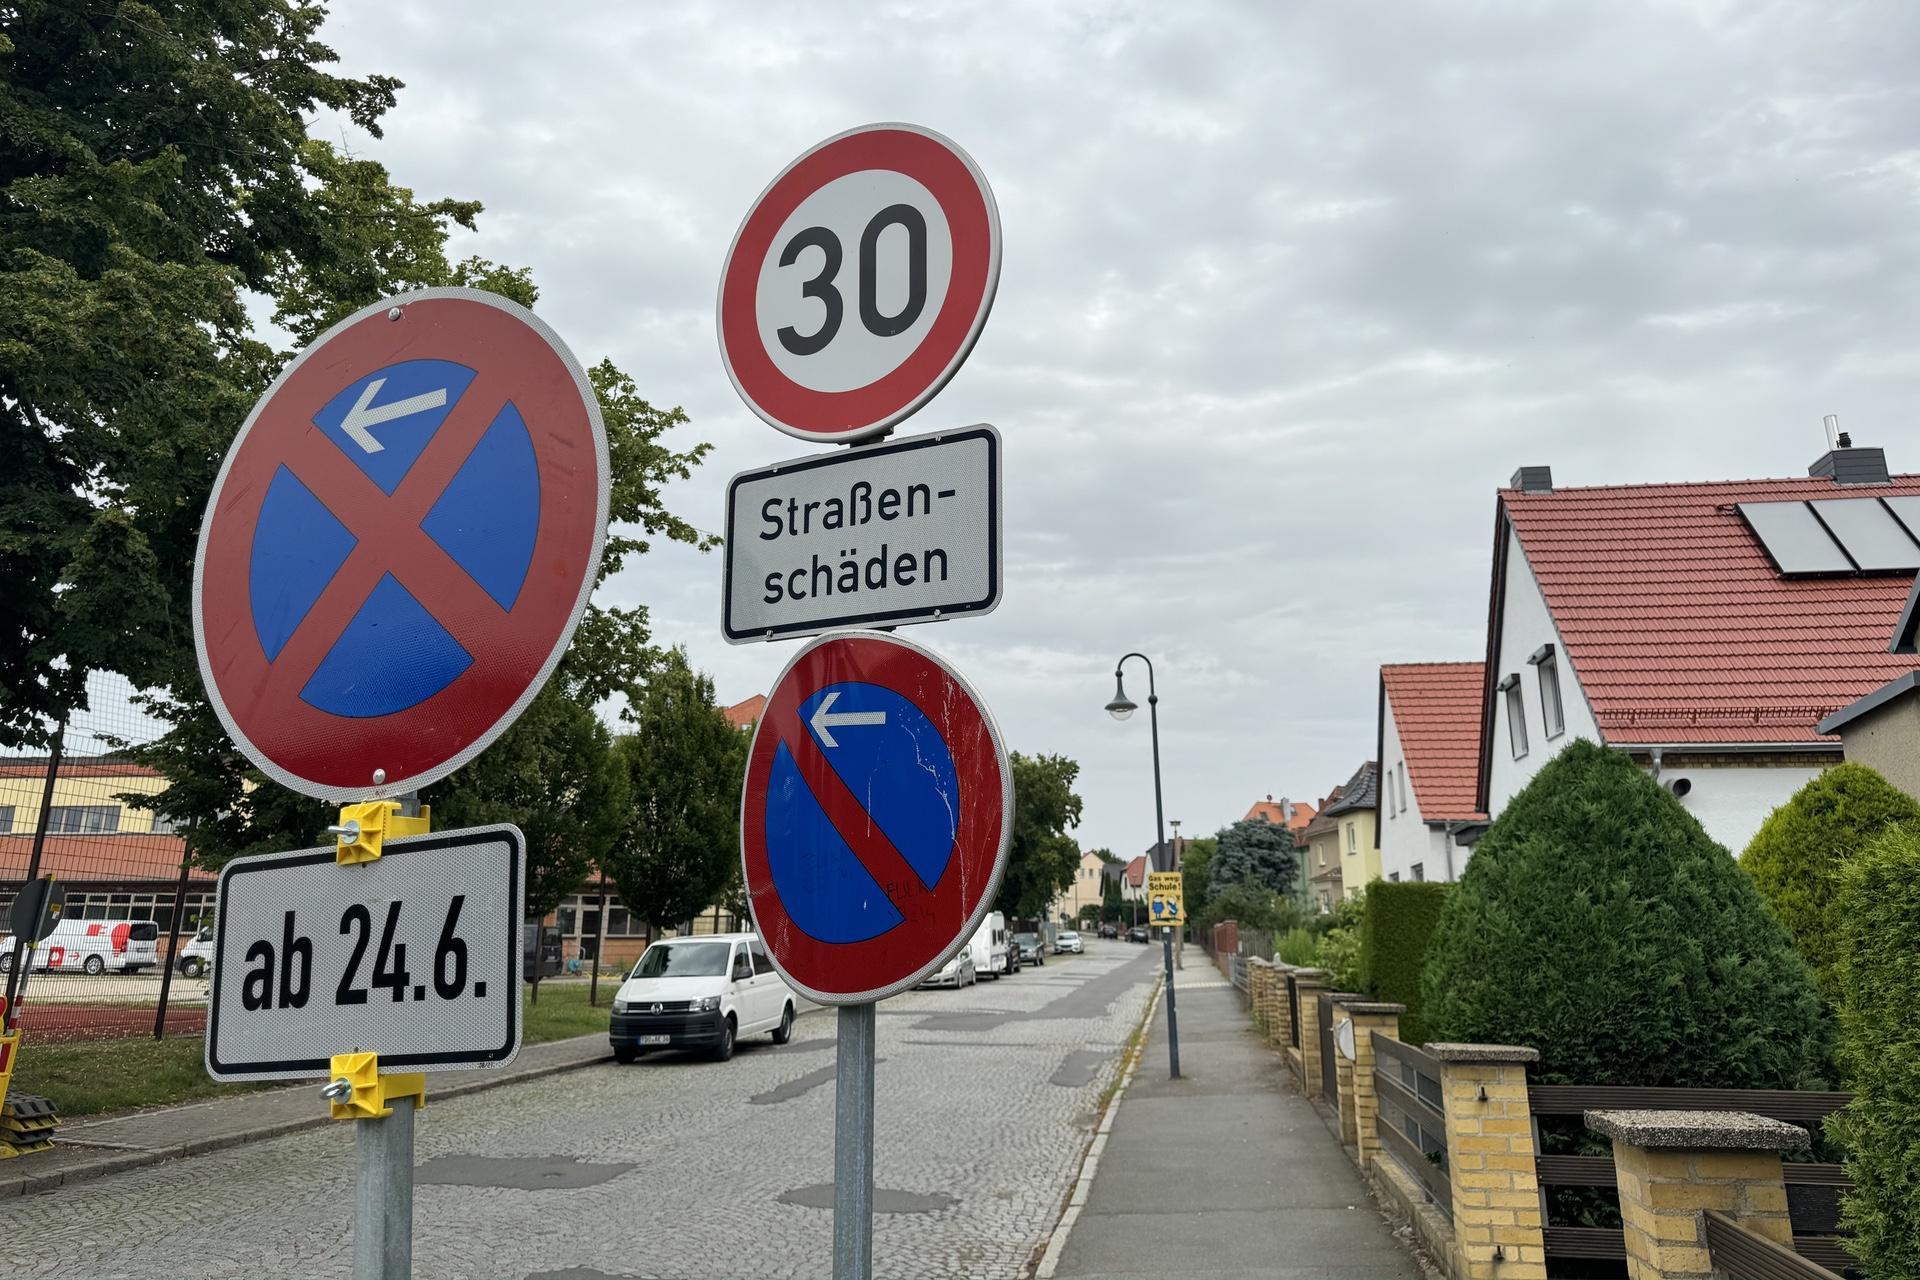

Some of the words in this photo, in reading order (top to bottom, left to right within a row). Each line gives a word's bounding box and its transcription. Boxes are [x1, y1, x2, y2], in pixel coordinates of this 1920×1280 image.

[776, 203, 928, 356] 30
[759, 481, 957, 541] Straßen-
[763, 543, 949, 605] schäden
[241, 910, 313, 1012] ab
[335, 894, 487, 1006] 24.6.
